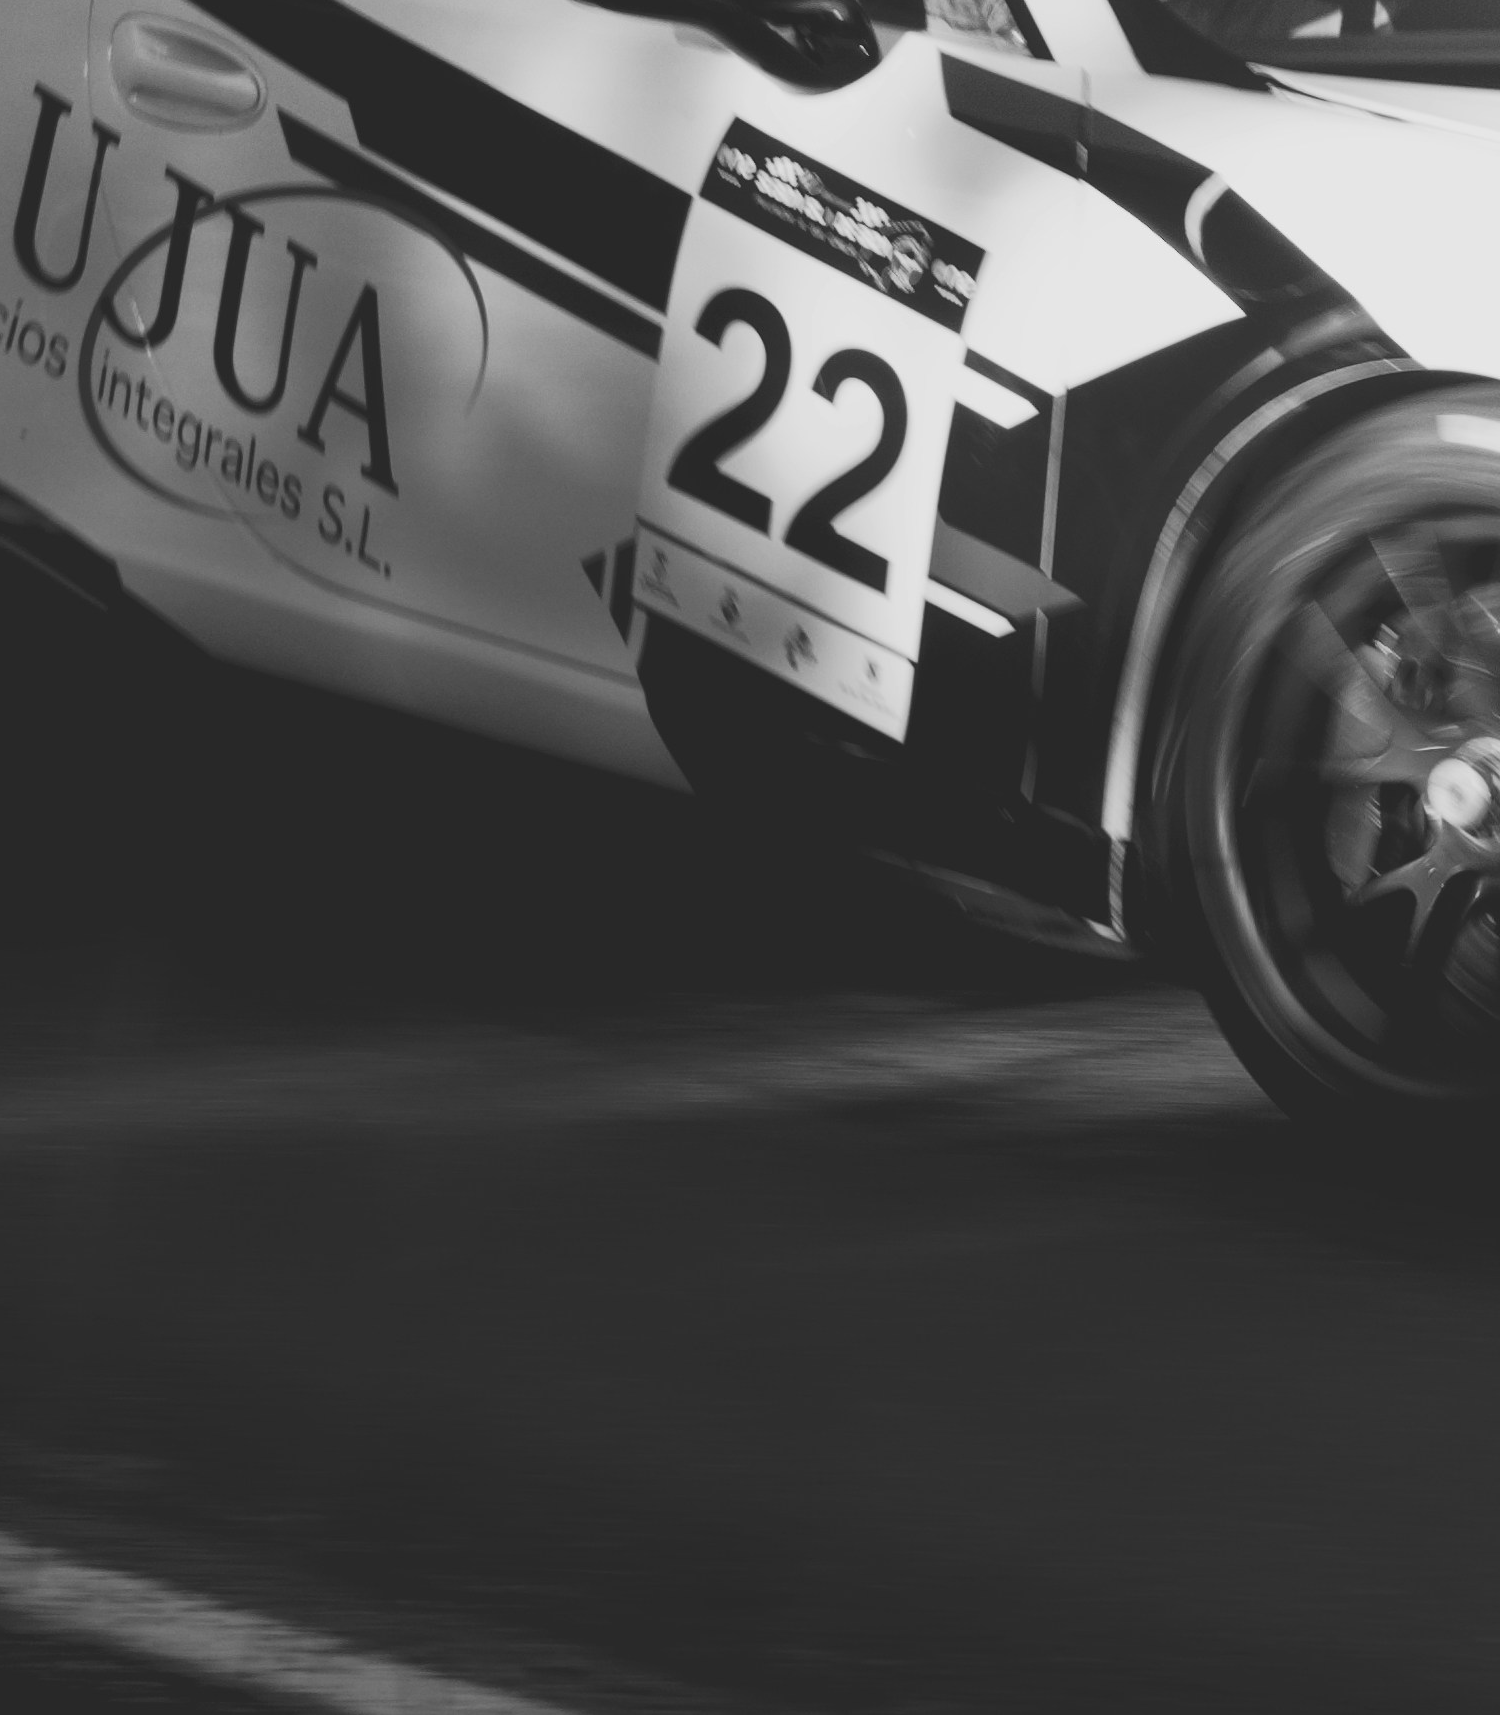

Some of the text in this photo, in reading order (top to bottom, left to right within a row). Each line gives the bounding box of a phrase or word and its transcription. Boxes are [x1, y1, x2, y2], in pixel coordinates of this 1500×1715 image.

[98, 349, 392, 579] integrales S.L.
[666, 288, 908, 598] 22
